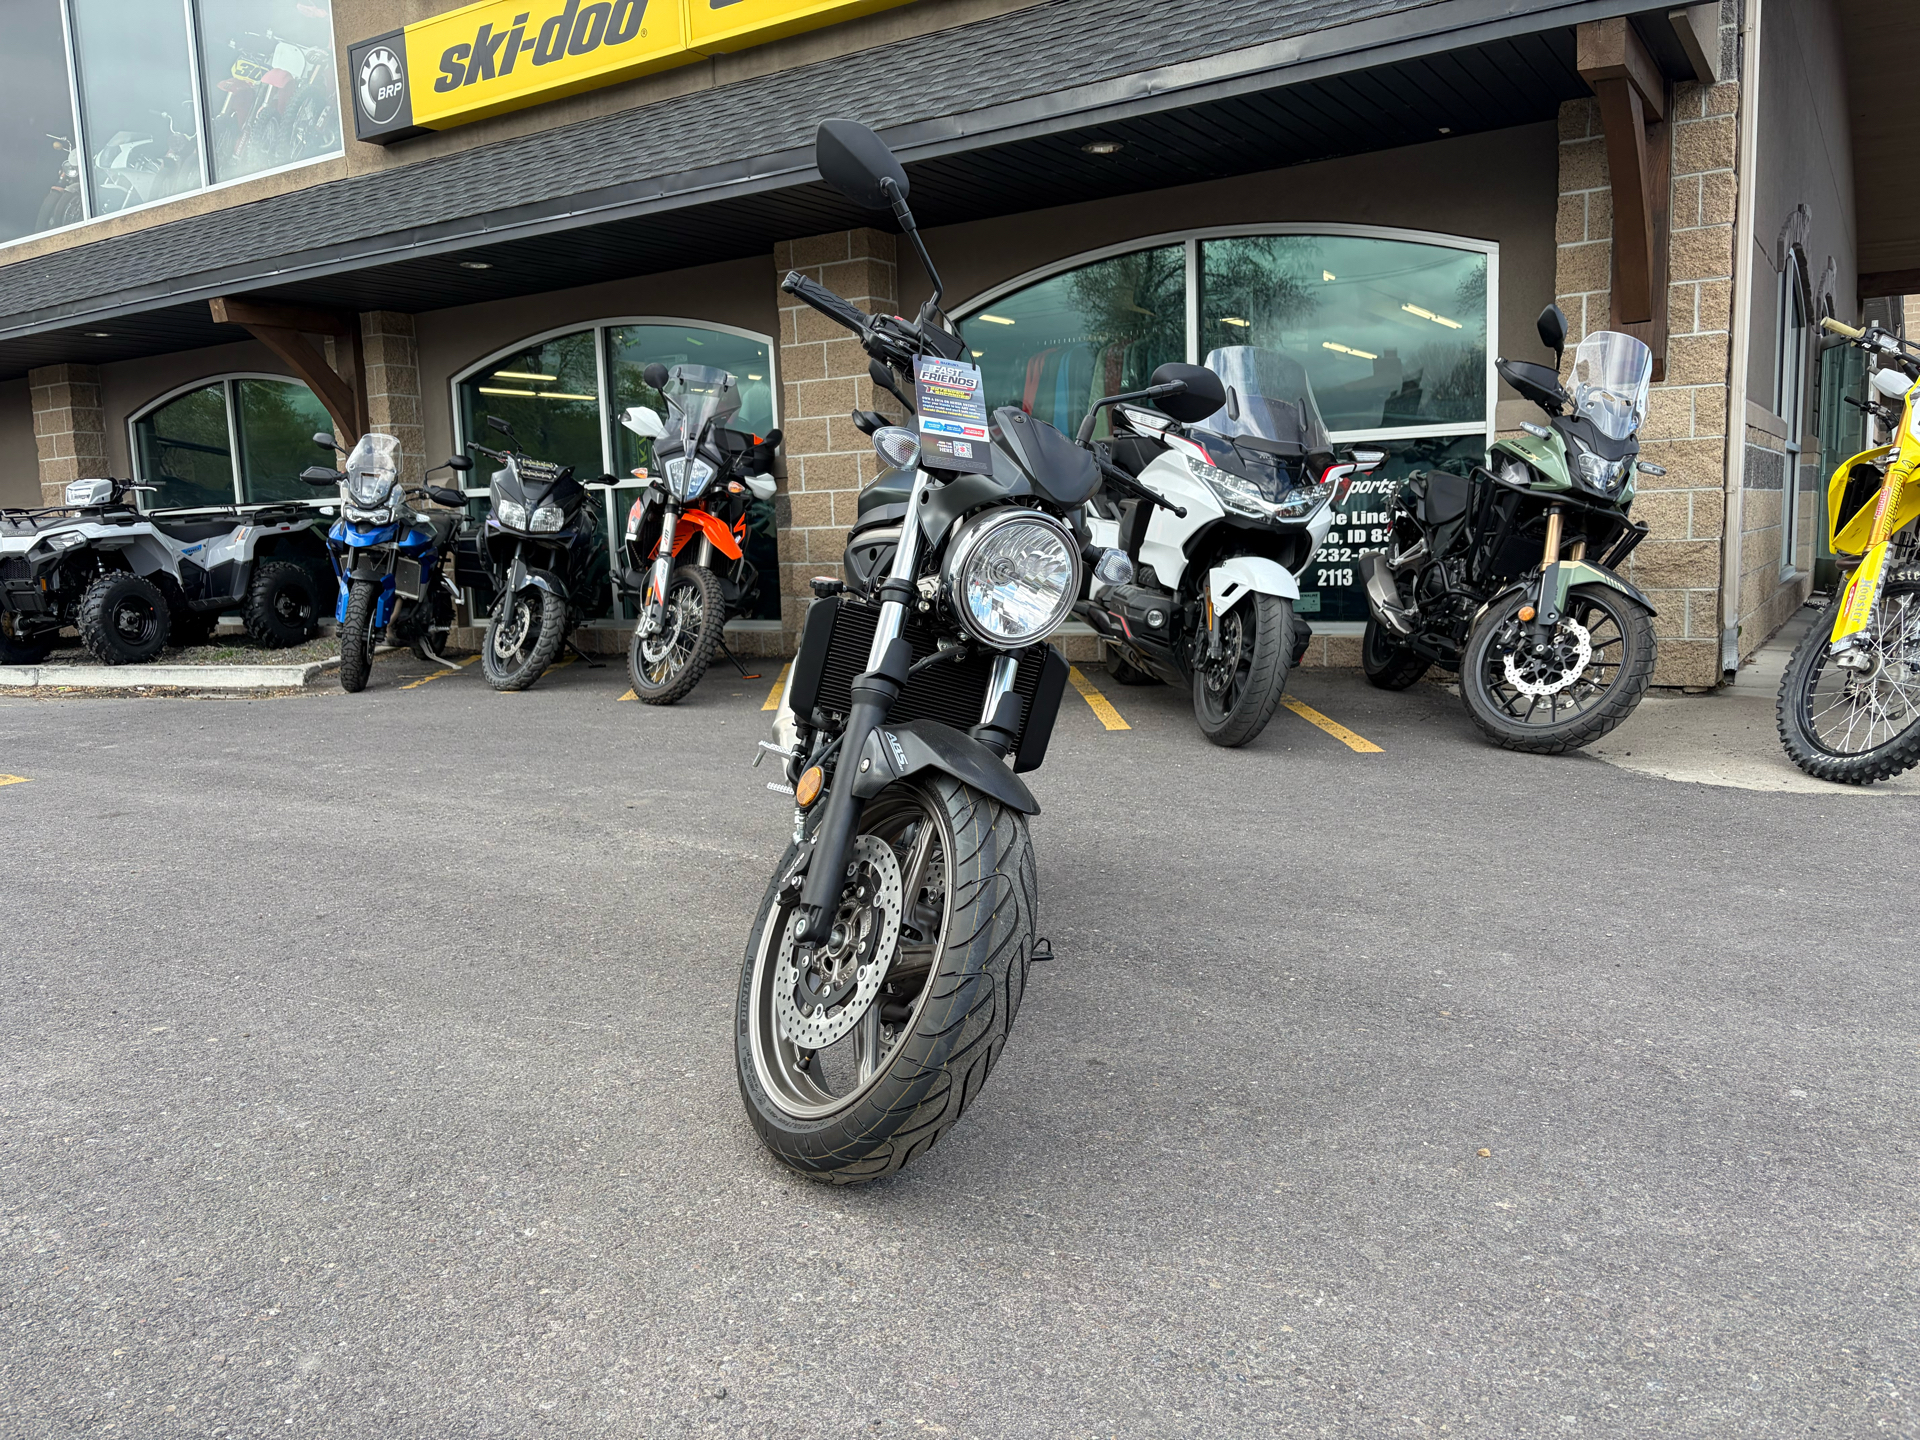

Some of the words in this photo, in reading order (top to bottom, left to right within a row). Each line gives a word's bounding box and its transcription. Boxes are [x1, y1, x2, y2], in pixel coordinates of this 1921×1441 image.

[434, 0, 648, 93] ski-doo
[378, 82, 402, 101] BRP
[921, 371, 975, 387] FRIENDS
[932, 365, 964, 377] FAST
[1342, 479, 1396, 506] ports
[1875, 489, 1888, 517] SHOWA
[1352, 511, 1390, 525] Line
[1347, 529, 1366, 543] ID
[1317, 568, 1353, 587] 2113
[1852, 577, 1873, 624] Hoosier
[884, 731, 909, 766] ABS
[741, 963, 753, 1021] DUNLOP
